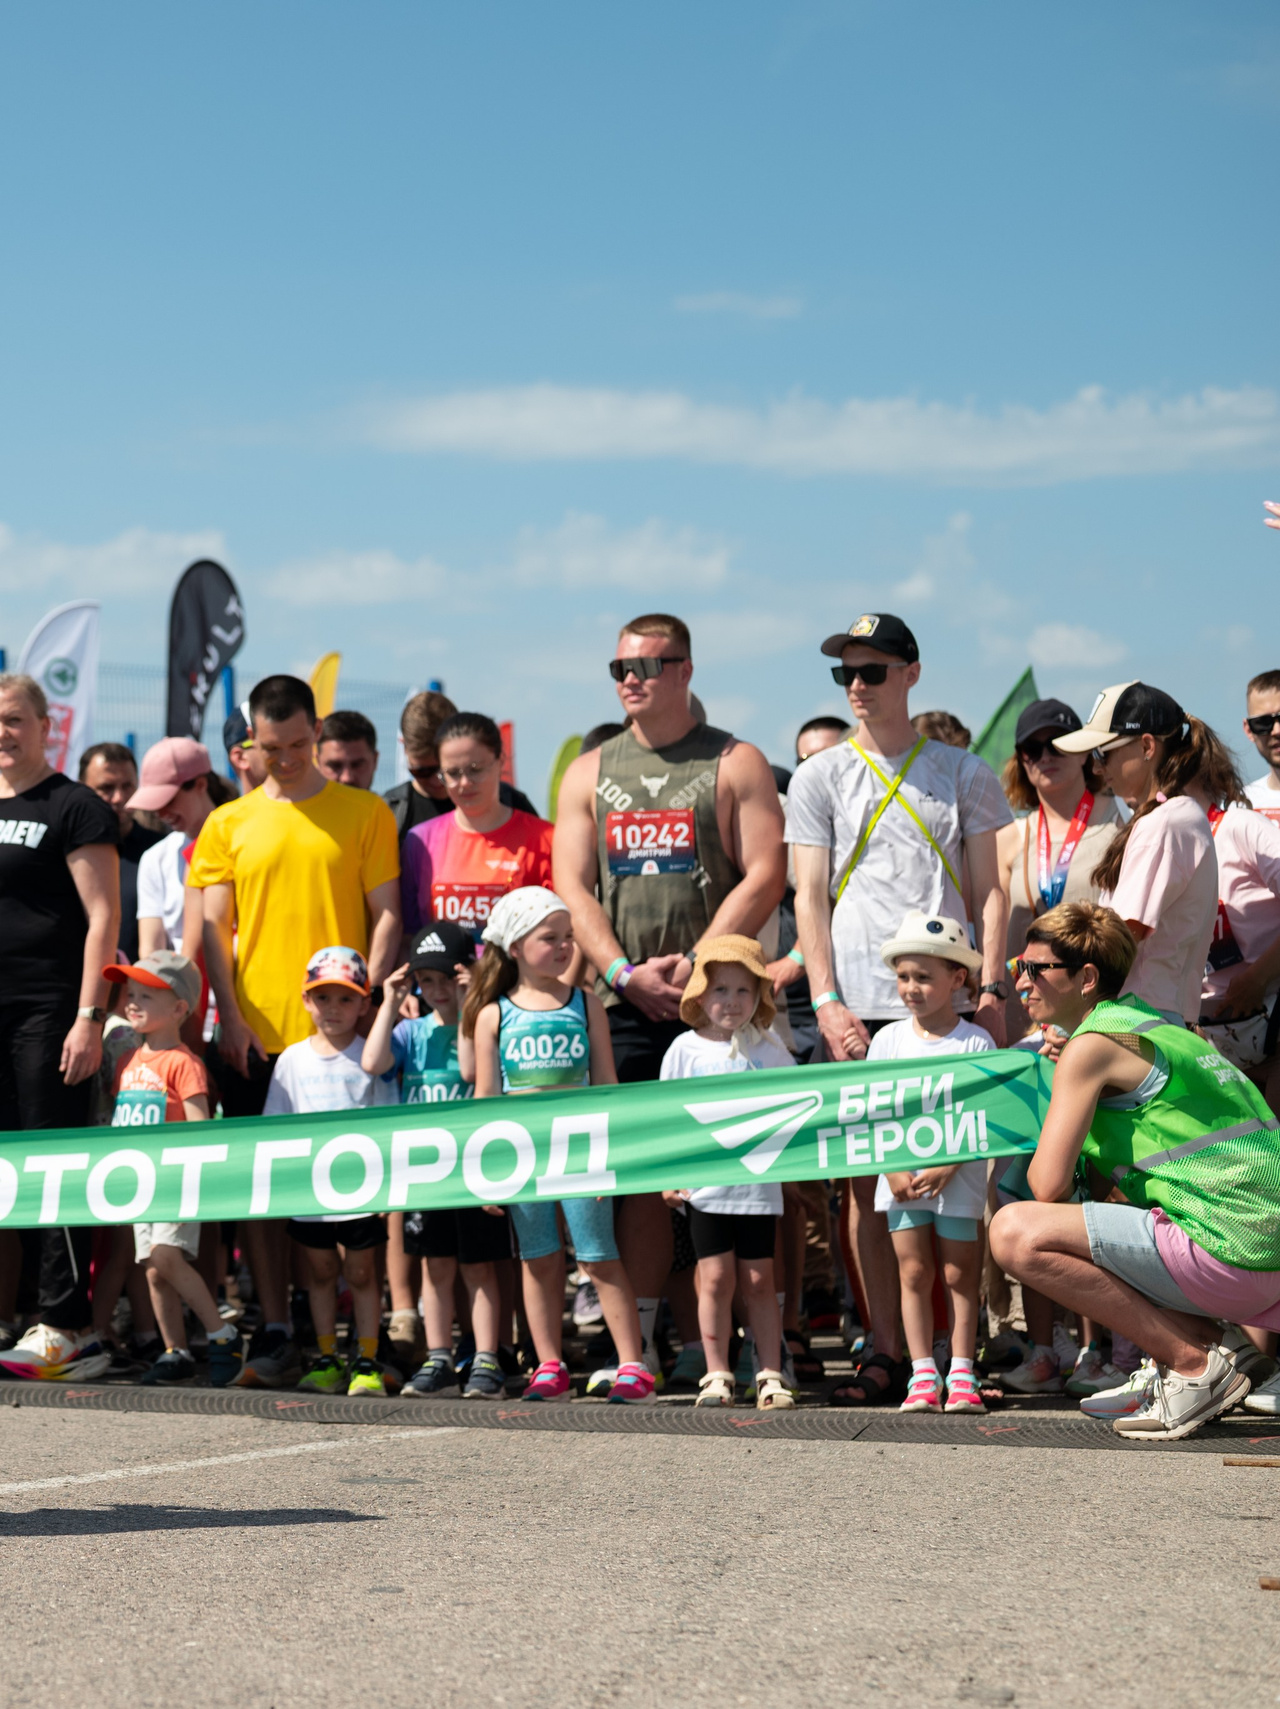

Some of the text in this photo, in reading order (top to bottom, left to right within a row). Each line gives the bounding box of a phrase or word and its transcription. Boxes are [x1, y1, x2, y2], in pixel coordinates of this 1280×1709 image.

[595, 777, 633, 812] 100
[611, 822, 690, 850] 10242
[628, 847, 672, 860] ДМИТРИЙ
[416, 944, 447, 955] adidas
[505, 1033, 585, 1063] 40026
[518, 1058, 574, 1071] МИРОСЛАВА
[837, 1072, 965, 1125] БЕГИ,
[816, 1109, 989, 1170] ГЕРОЙ!
[249, 1112, 617, 1216] ГОРОД
